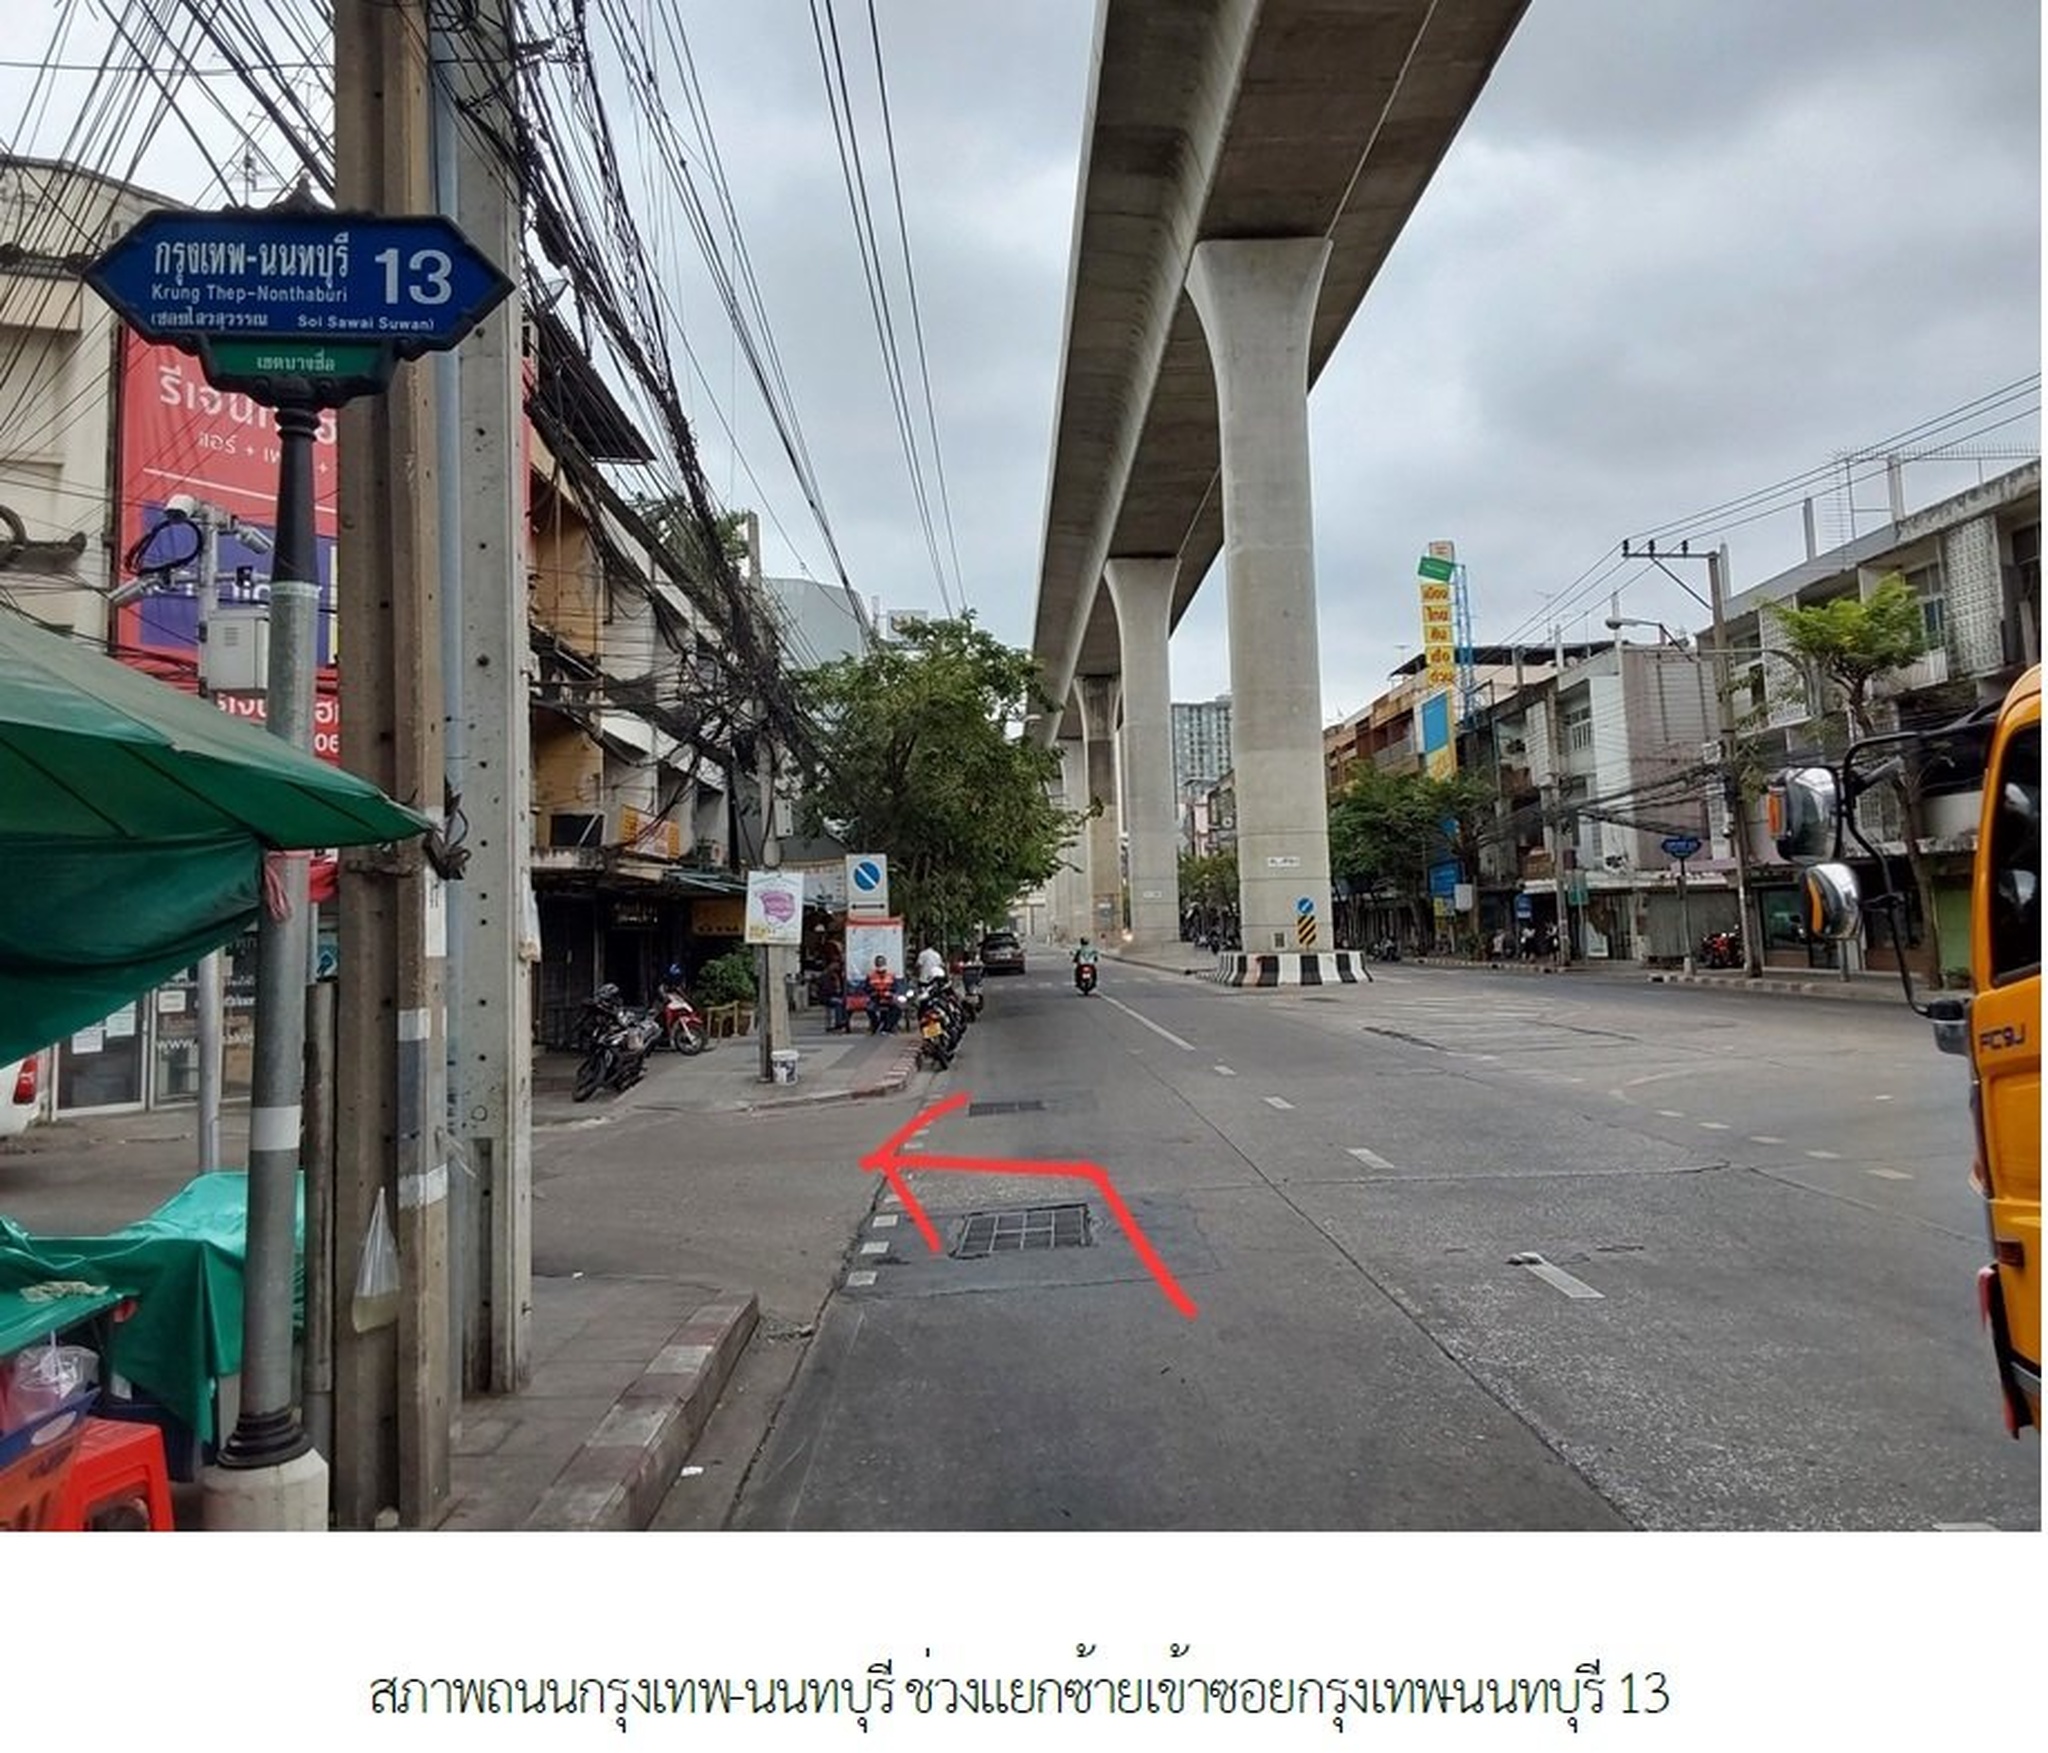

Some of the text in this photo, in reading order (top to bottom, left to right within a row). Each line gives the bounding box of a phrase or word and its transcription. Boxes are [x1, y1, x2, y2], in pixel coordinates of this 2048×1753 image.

[154, 231, 453, 305] กรุงเทพ-นนทบุรี 13
[151, 283, 348, 304] Krung Thep-Nonthaburi
[297, 314, 323, 328] Soi
[327, 315, 374, 330] Sawai
[378, 316, 435, 331] Suwan)
[256, 350, 336, 372] เขตบางซื่อ
